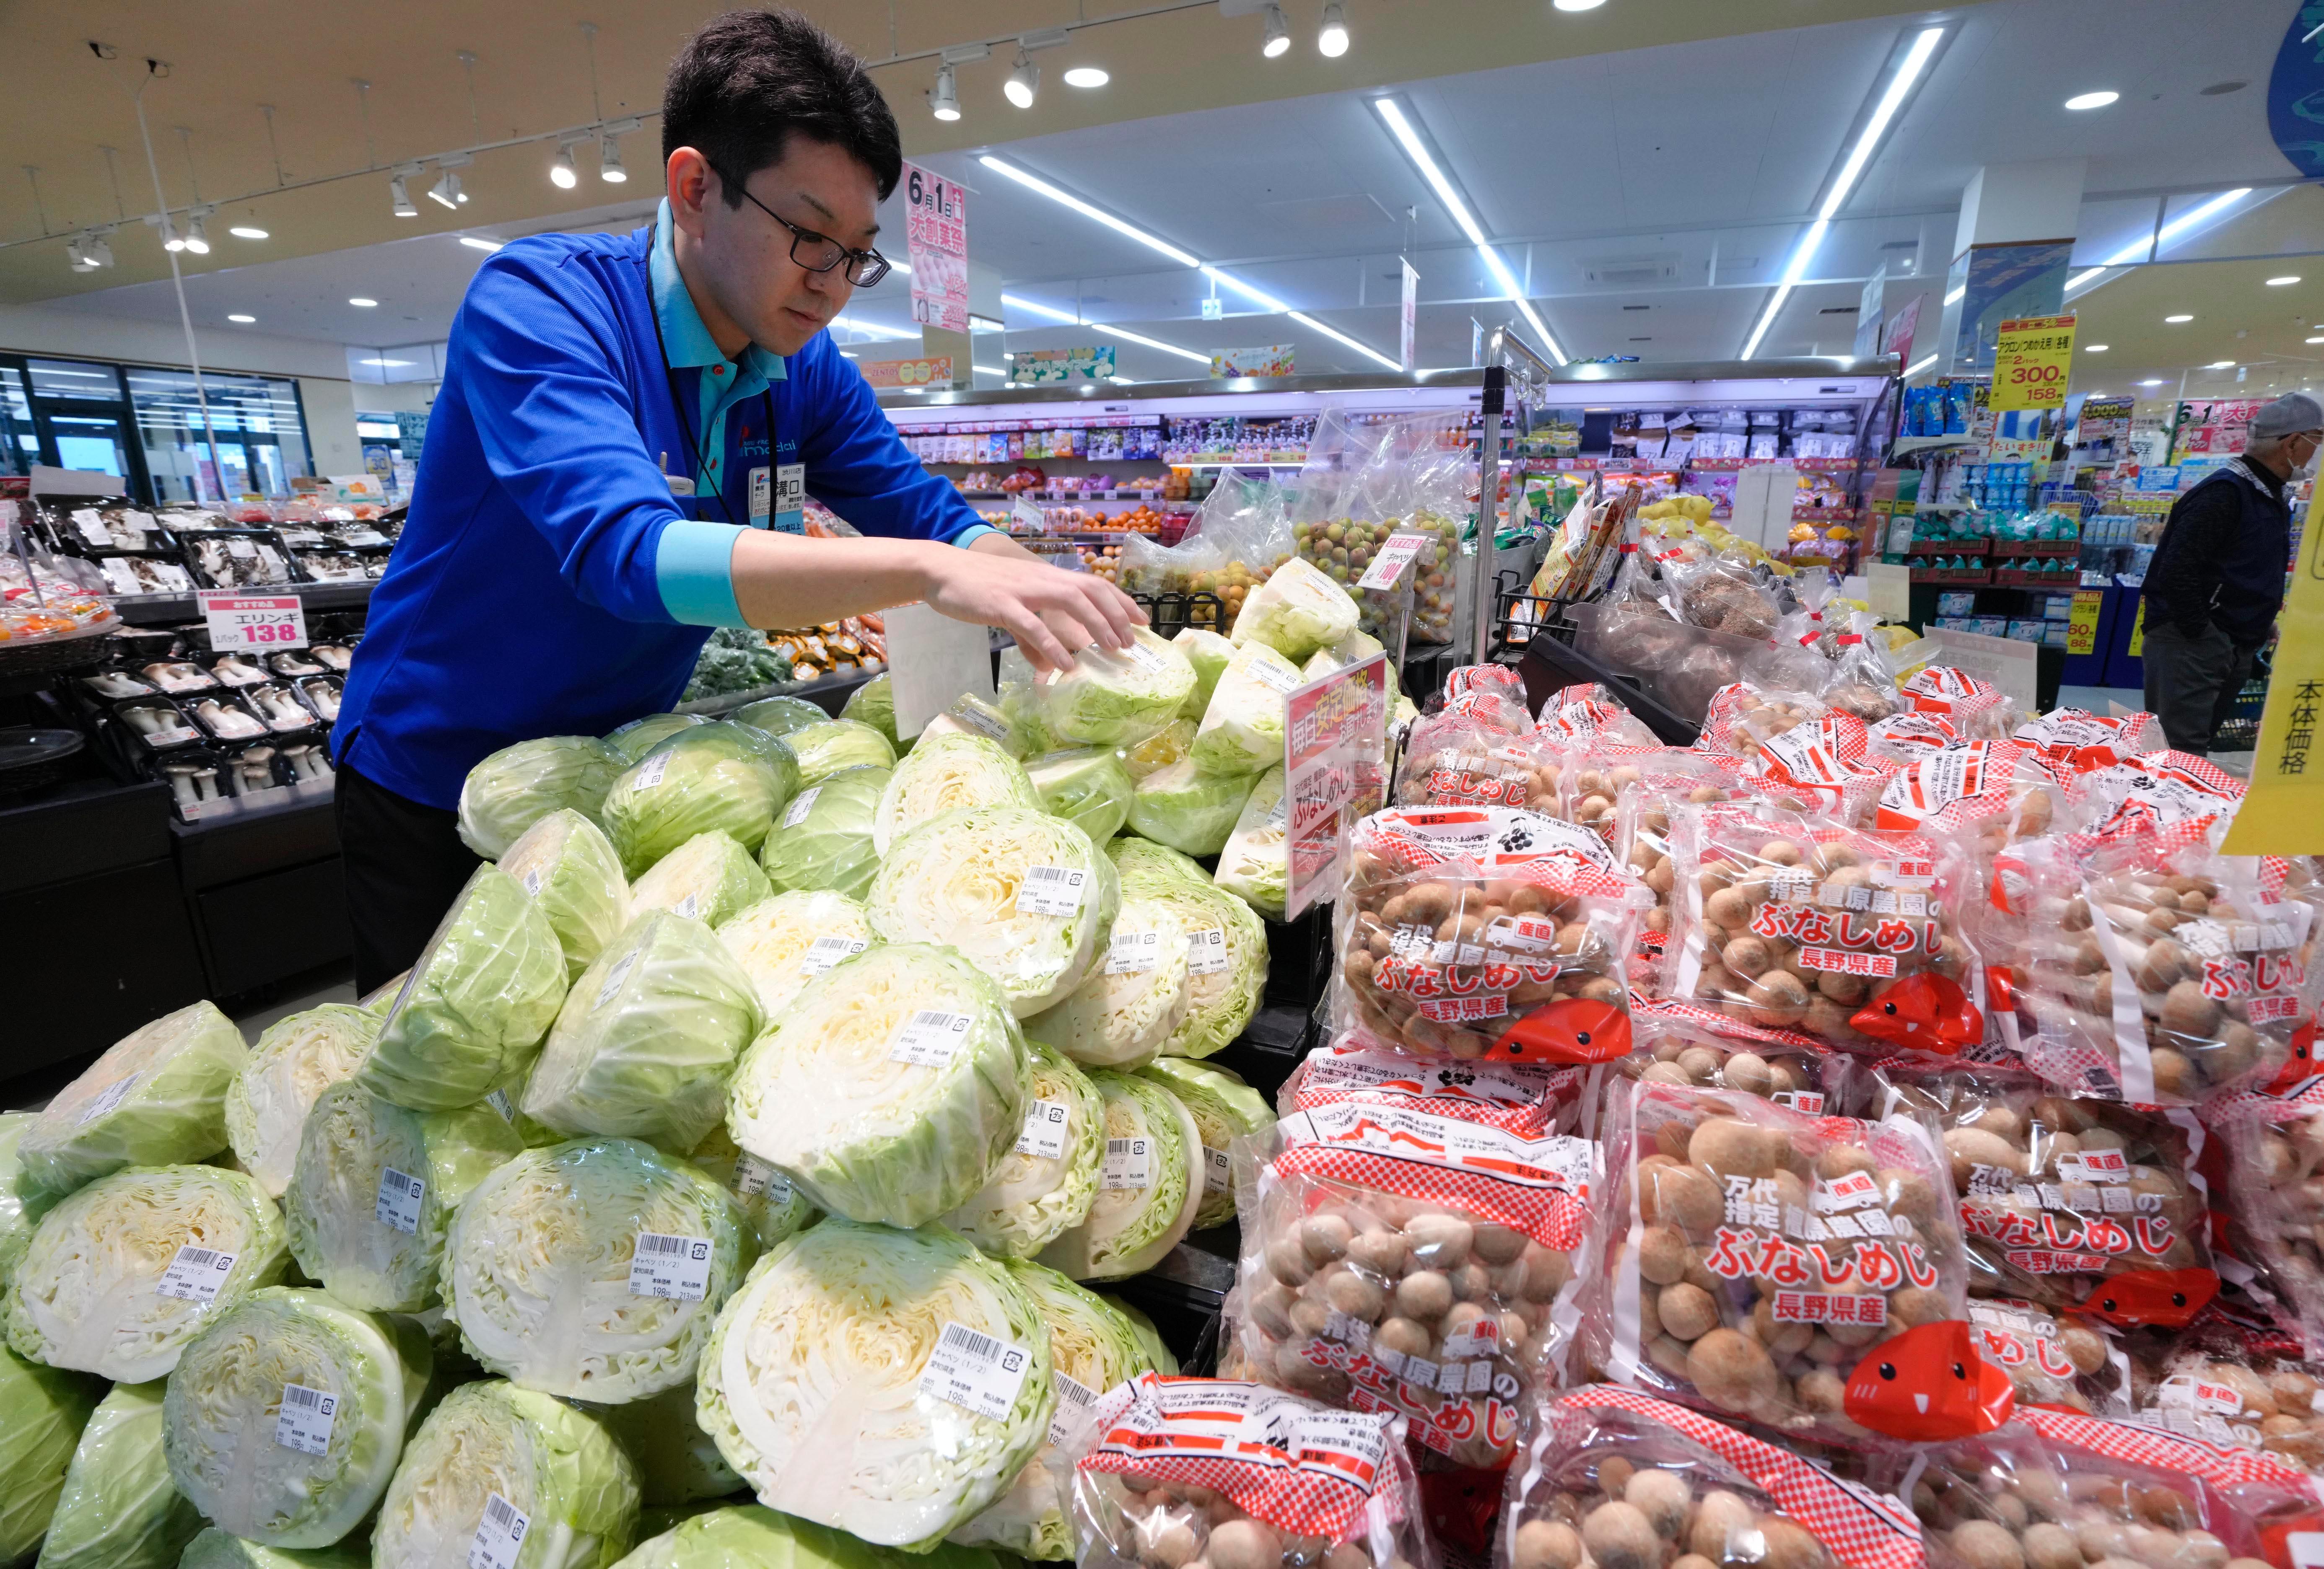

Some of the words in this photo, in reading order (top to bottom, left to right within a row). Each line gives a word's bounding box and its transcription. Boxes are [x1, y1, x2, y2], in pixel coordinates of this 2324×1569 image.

[909, 212, 965, 255] 大創業祭
[1388, 538, 1420, 549] おすすめ品
[1387, 553, 1411, 563] キャベツ
[1379, 562, 1402, 580] 100
[235, 613, 298, 624] エリンギ
[2279, 678, 2324, 775] 本体価格
[1293, 766, 1349, 830] ぶなしめじ
[1419, 814, 1446, 824] ご注意
[1899, 861, 1934, 876] 産直
[1769, 883, 1812, 904] 指定
[1035, 905, 1049, 914] 198円
[1518, 922, 1551, 942] 産直
[1799, 946, 1897, 978] 長野県産
[1418, 995, 1509, 1023] 長野県産
[906, 1054, 921, 1064] 198円
[1797, 1094, 1823, 1112] 産直
[1039, 1140, 1058, 1148] 税込価格
[1036, 1149, 1058, 1160] 213.84円
[2084, 1154, 2127, 1170] 産直
[735, 1166, 753, 1176] 愛知県産
[1516, 1164, 1562, 1181] 理方法
[1971, 1163, 2012, 1187] 万代
[748, 1177, 765, 1186] 本体価格
[772, 1183, 788, 1193] 税込価格
[1725, 1173, 1780, 1201] 万代
[1830, 1173, 1877, 1198] 産直
[747, 1185, 763, 1196] 198円
[768, 1192, 787, 1203] 213.84円
[1724, 1196, 1780, 1230] 指定
[388, 1217, 399, 1230] 198円
[1959, 1201, 2177, 1256] ぶなしめじ
[634, 1257, 680, 1269] キャベツ（1／2）
[1704, 1226, 1939, 1291] ぶなしめじ
[2005, 1250, 2109, 1274] 長野県産
[170, 1265, 205, 1276] キャベツ（1／2）
[633, 1267, 655, 1276] 愛知県産
[681, 1281, 701, 1289] 税込価格
[173, 1289, 189, 1299] 198円
[652, 1287, 671, 1298] 198円
[678, 1292, 702, 1302] 213.84円
[1773, 1289, 1888, 1326] 長野県産
[929, 1360, 956, 1376] 愛知県産
[923, 1377, 935, 1386] 0005
[947, 1390, 969, 1408] 198円
[949, 1378, 972, 1393] 本体価格
[983, 1392, 1006, 1407] 税込価格
[1300, 1337, 1520, 1450] ぶなしめじ
[291, 1438, 304, 1451] 198円
